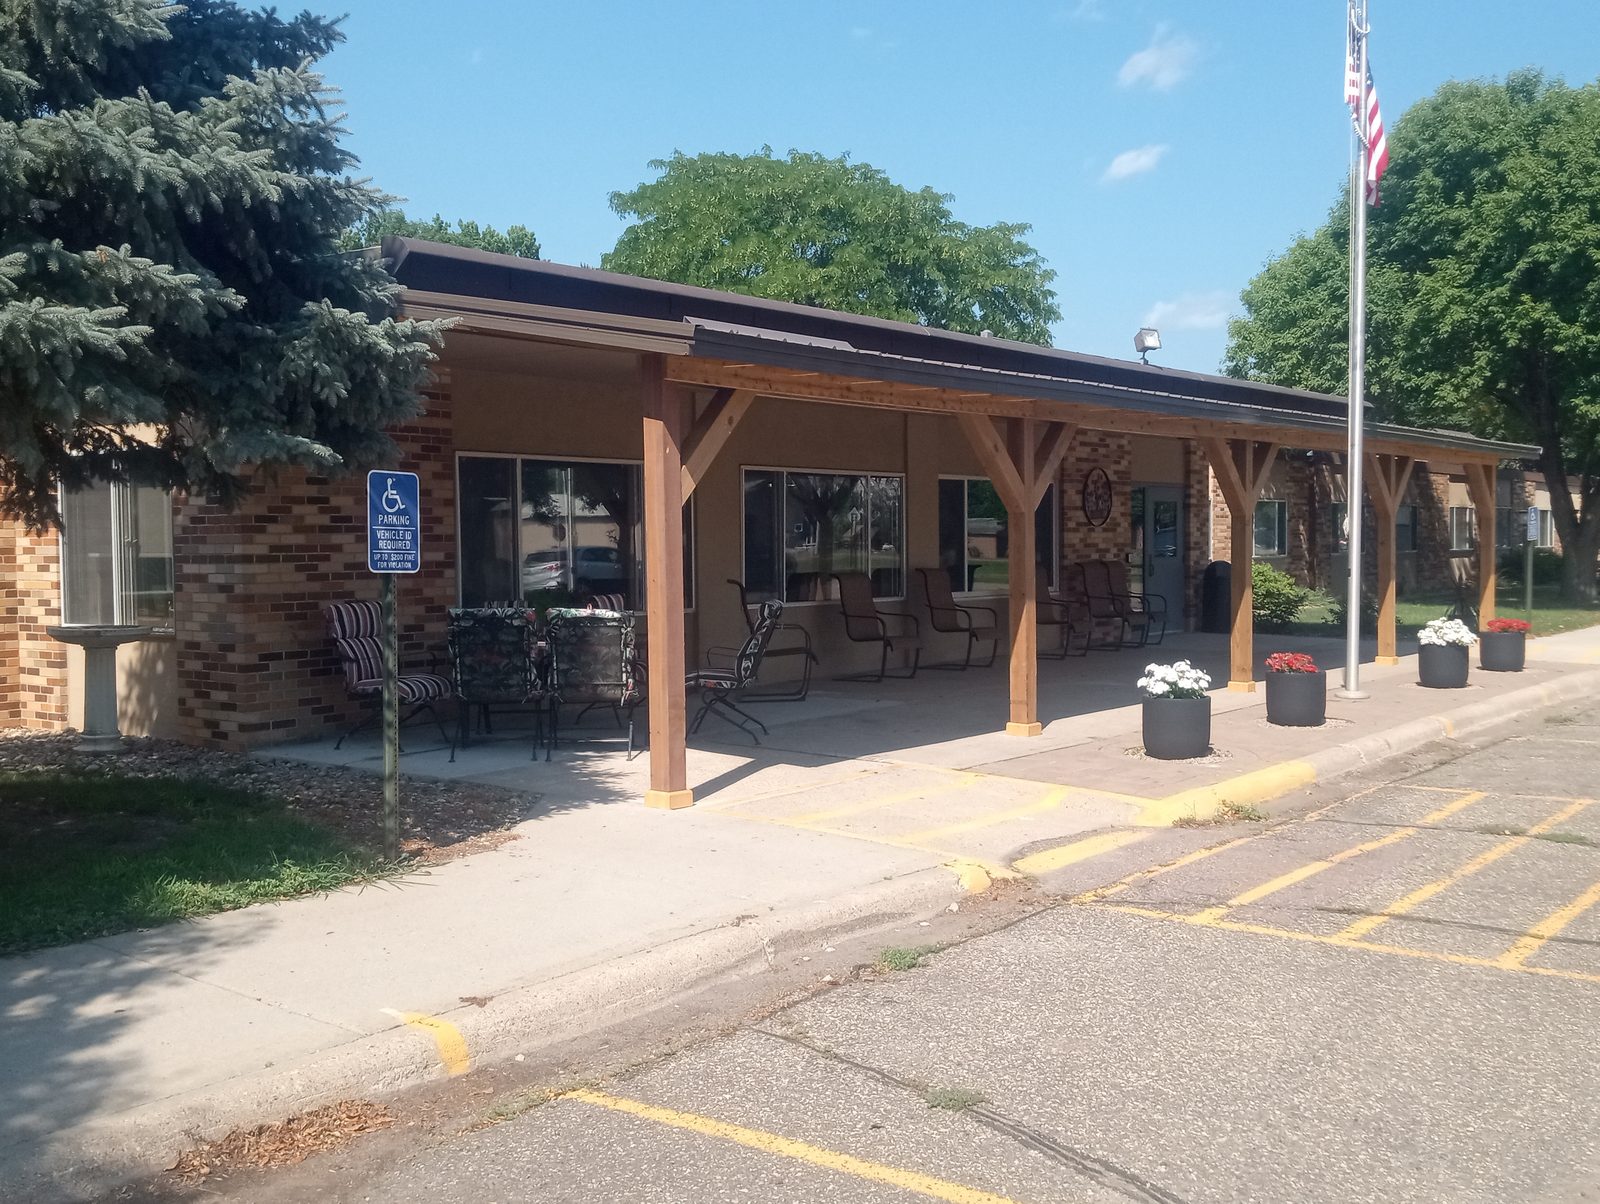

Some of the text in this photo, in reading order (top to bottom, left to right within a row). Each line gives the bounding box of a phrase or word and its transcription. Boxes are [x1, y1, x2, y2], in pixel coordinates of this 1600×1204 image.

[378, 514, 410, 525] PARKING
[376, 530, 412, 540] VEHICLE ID
[378, 540, 411, 549] REQUIRED
[382, 553, 388, 561] TO
[391, 553, 404, 561] $200
